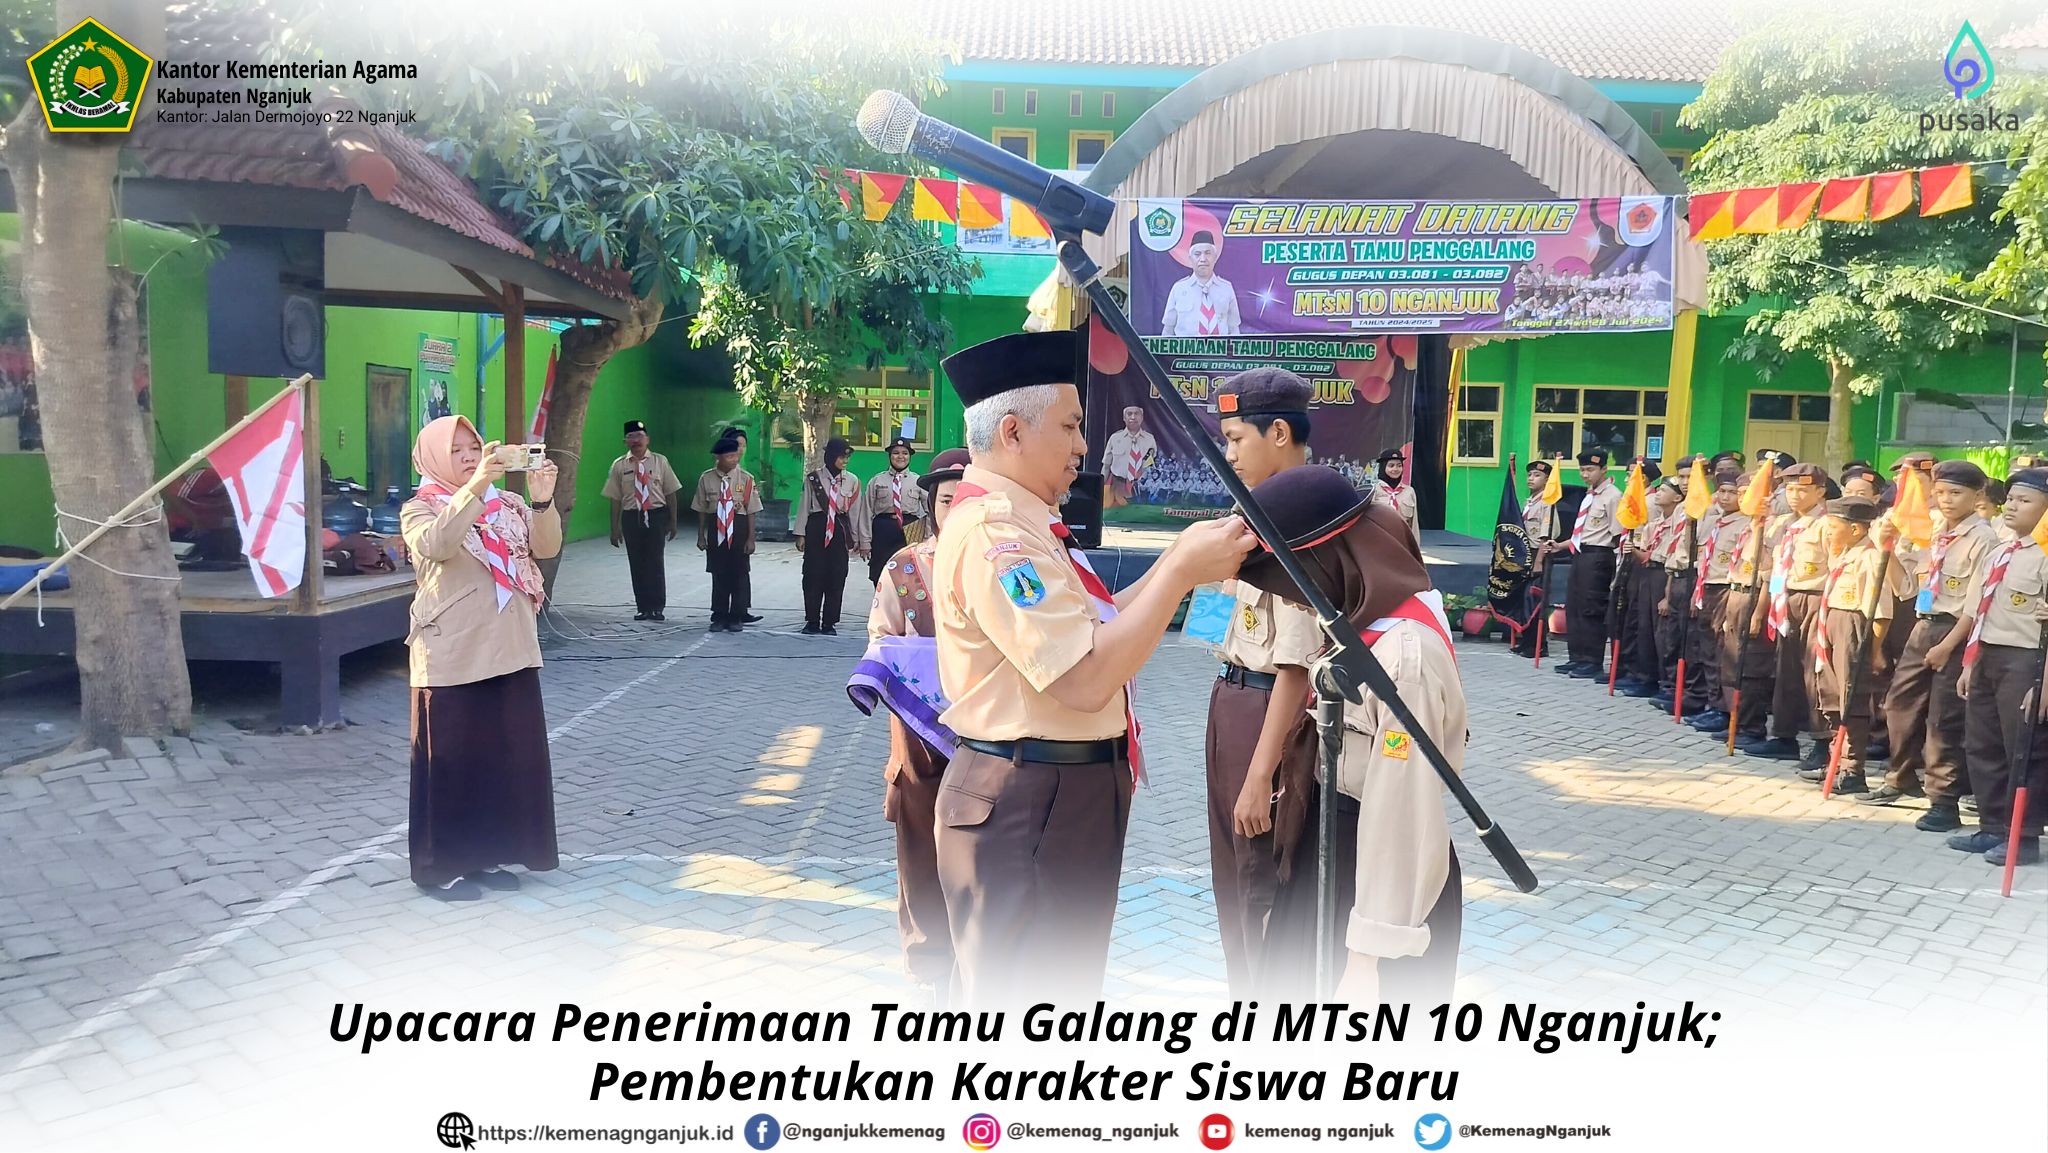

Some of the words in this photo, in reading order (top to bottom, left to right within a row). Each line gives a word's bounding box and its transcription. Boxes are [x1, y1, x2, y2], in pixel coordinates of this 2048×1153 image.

[1225, 203, 1414, 237] SELAMAT
[1414, 202, 1579, 235] DATANG
[1262, 240, 1348, 264] PESERTA
[1351, 239, 1406, 263] TAMU
[1408, 239, 1536, 262] PENGGALANG
[1292, 270, 1337, 281] GUGUS
[1341, 270, 1385, 280] DEPAN
[1388, 269, 1438, 280] 03.081
[1452, 269, 1504, 279] 03.082
[1294, 290, 1353, 316] MTsN
[1356, 289, 1387, 315] 10
[1390, 288, 1501, 315] NGANJUK
[1511, 319, 1552, 328] Tanggal
[1609, 318, 1629, 326] Juli
[1231, 340, 1273, 356] TAMU
[1275, 341, 1377, 360] PENGGALANG
[1175, 362, 1209, 370] GUGUS
[1293, 364, 1331, 372] 03.082
[1150, 375, 1208, 400] TsN
[1163, 507, 1210, 518] Tanggal
